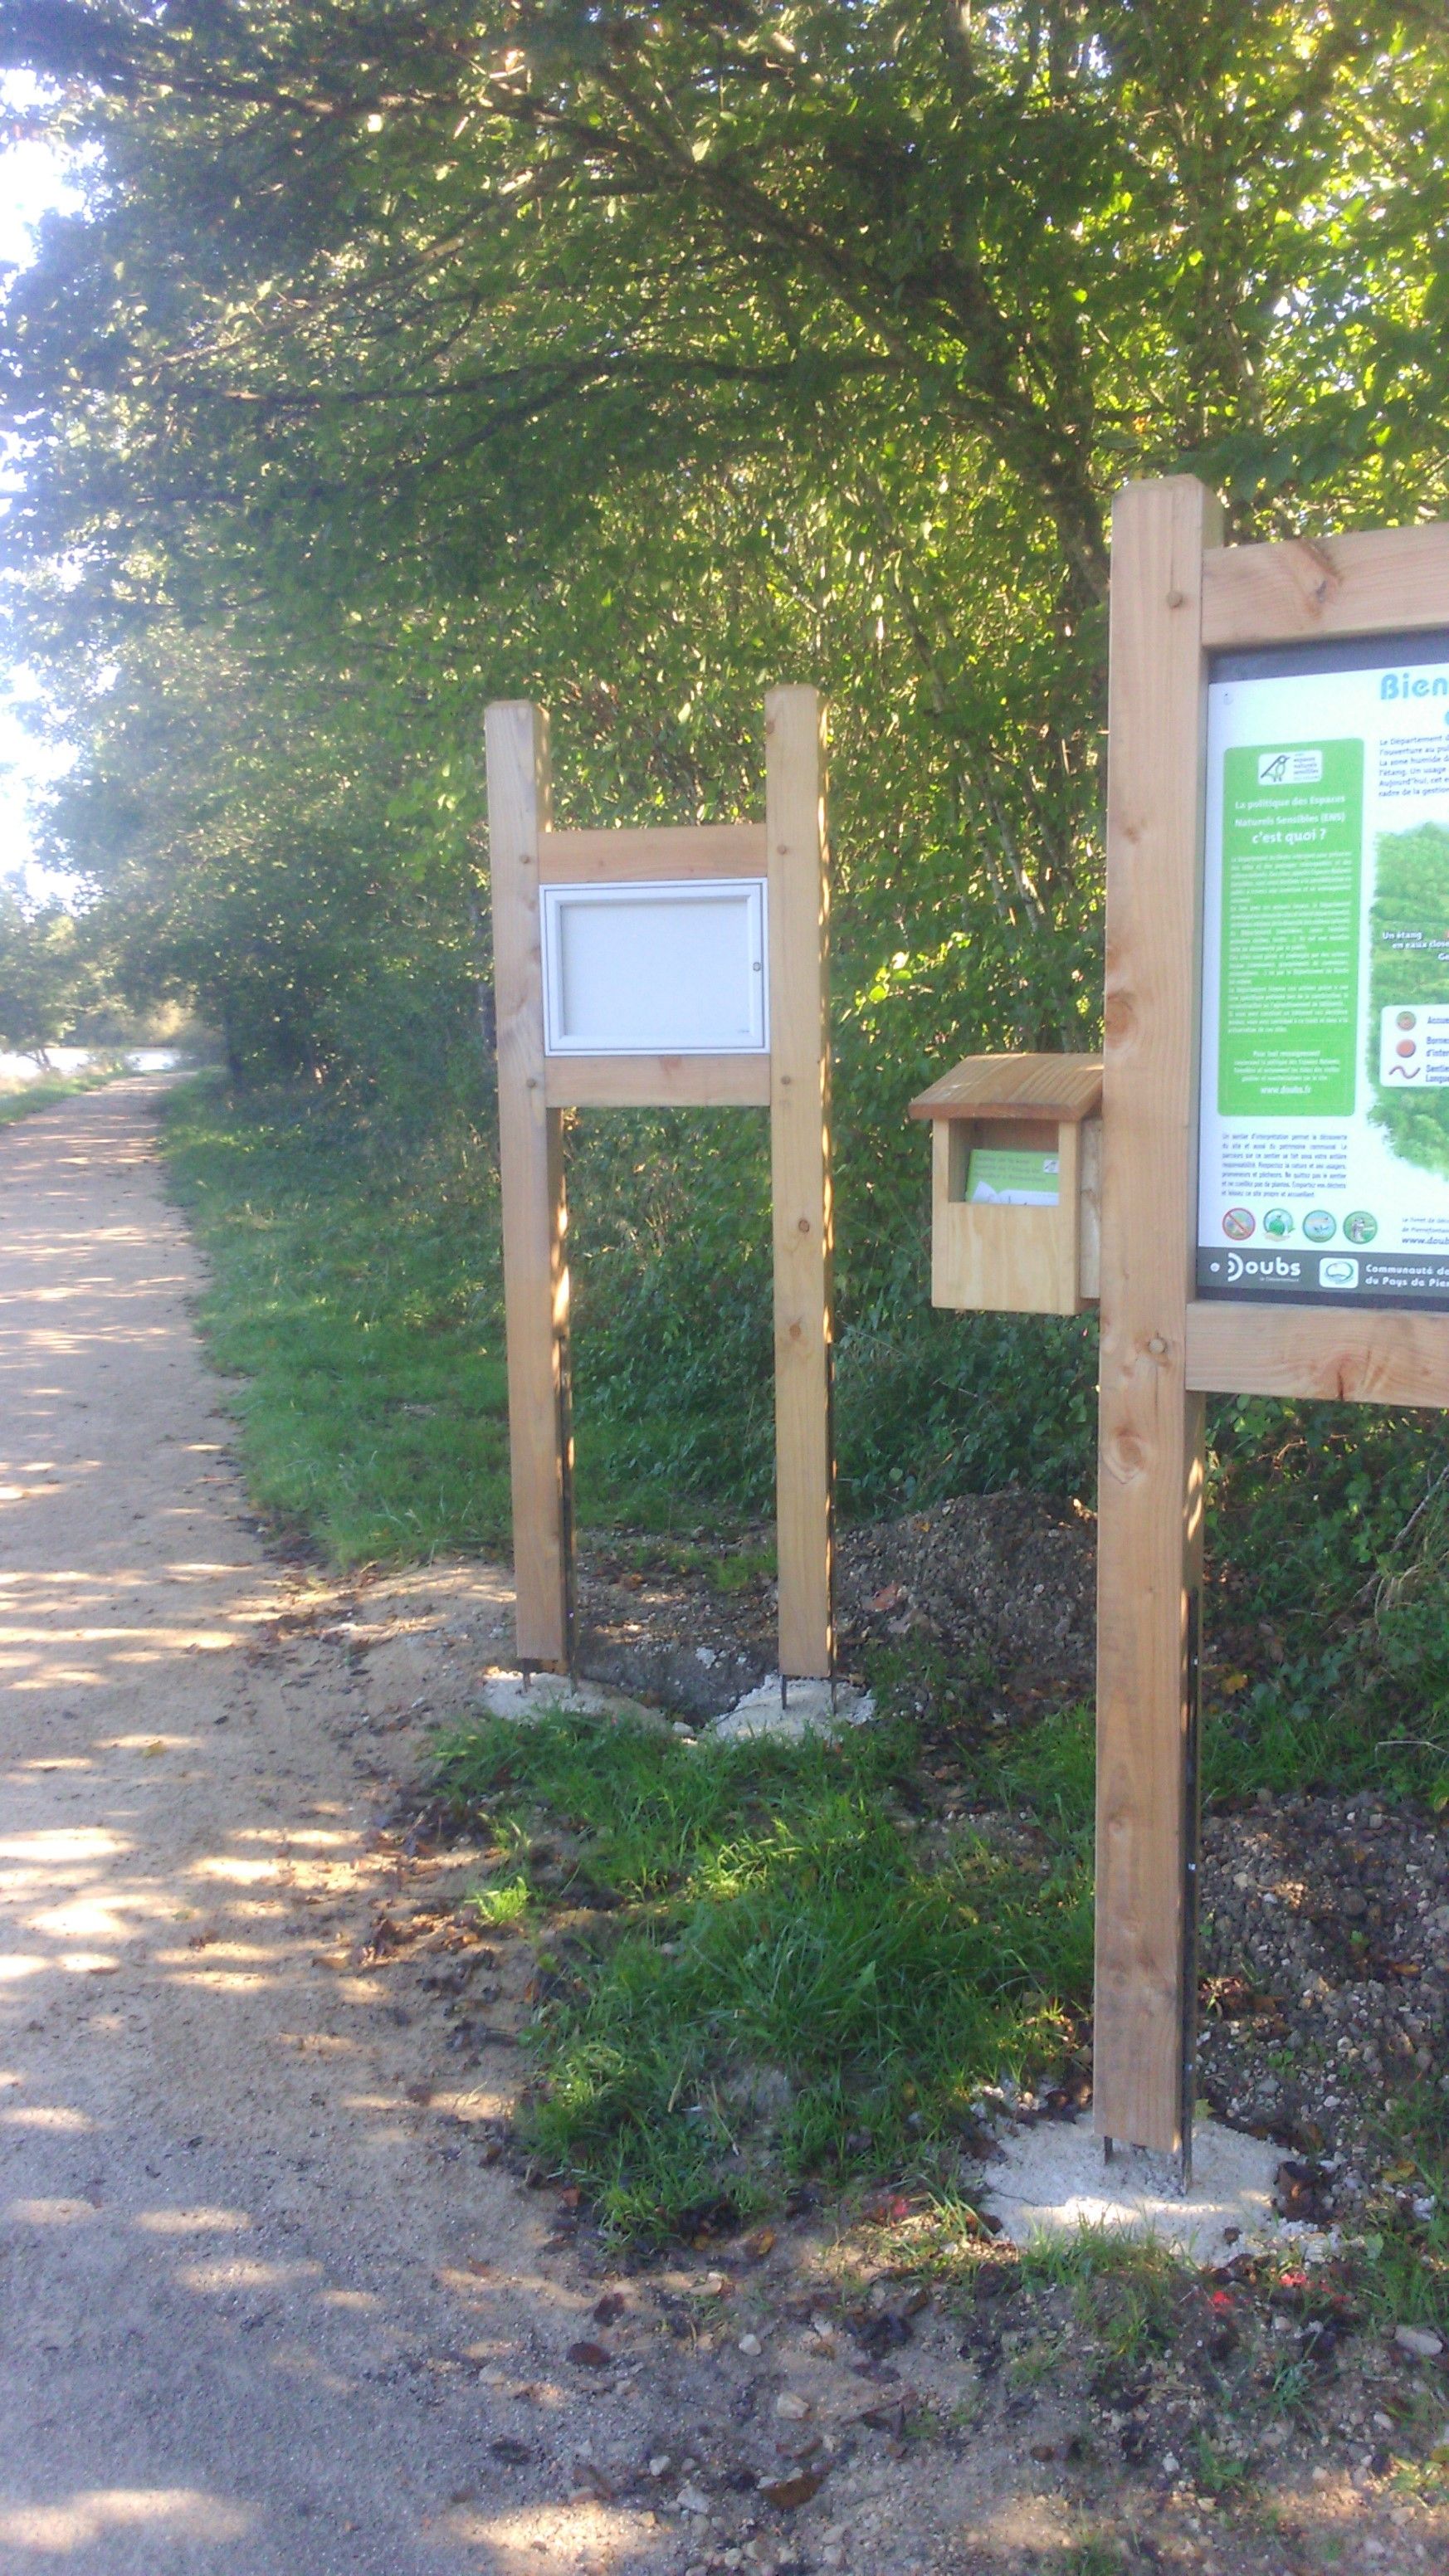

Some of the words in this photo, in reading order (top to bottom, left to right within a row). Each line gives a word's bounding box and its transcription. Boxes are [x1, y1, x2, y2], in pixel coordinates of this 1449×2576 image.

[1381, 672, 1448, 700] Bien
[1252, 832, 1281, 844] c'est
[1285, 829, 1315, 845] quoi
[1227, 1252, 1301, 1282] Doubs
[1366, 1264, 1433, 1276] Communauté
[1365, 1276, 1379, 1285] du
[1383, 1276, 1408, 1287] Pays
[1411, 1277, 1425, 1287] de
